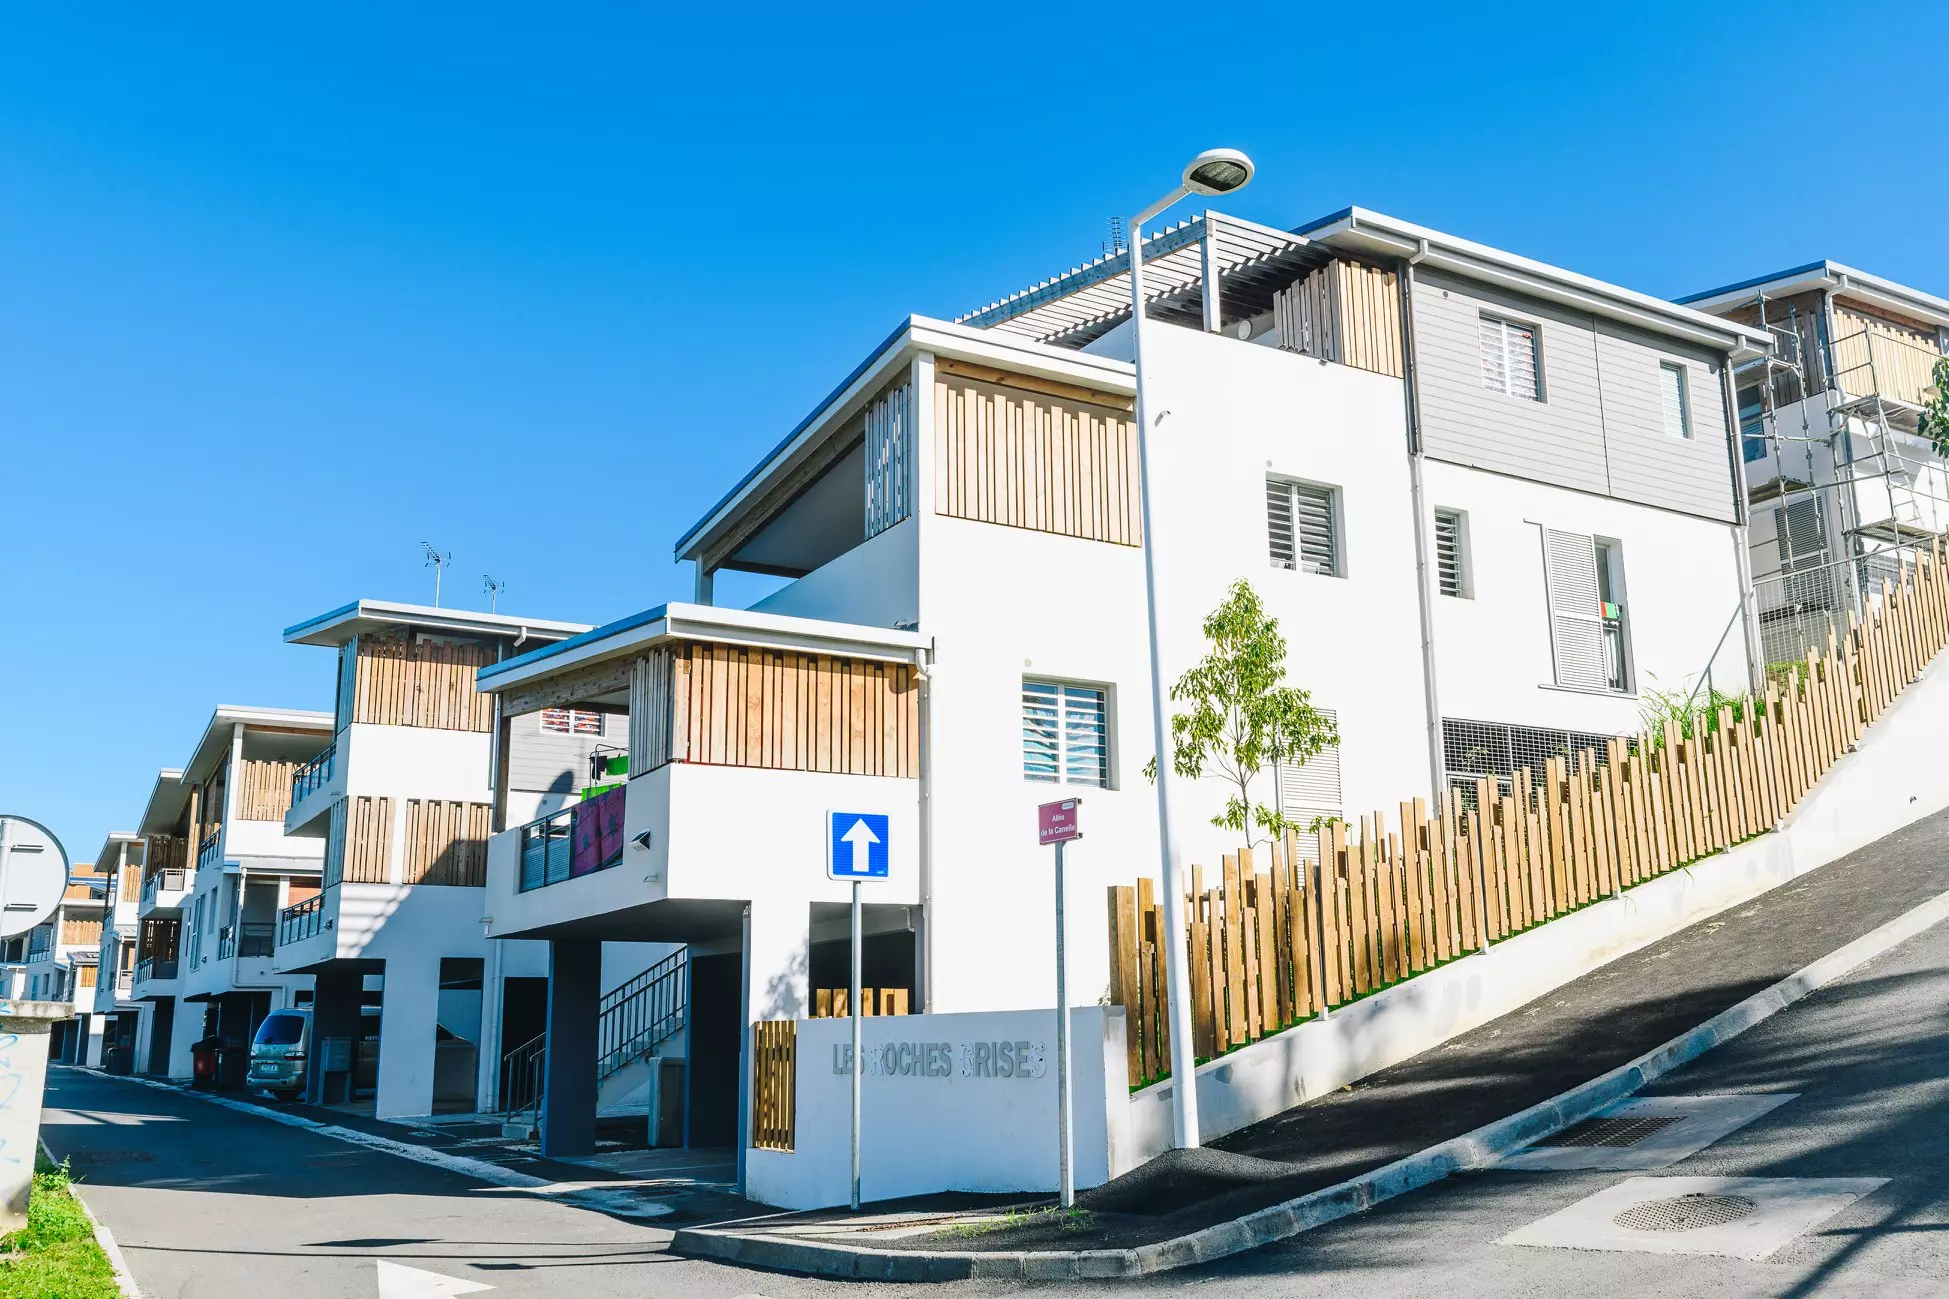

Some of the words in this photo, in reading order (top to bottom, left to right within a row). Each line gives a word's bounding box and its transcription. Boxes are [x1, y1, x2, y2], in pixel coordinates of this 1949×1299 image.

[1040, 829, 1048, 837] de
[1048, 827, 1054, 835] la
[870, 1042, 952, 1077] ROCHES
[959, 1040, 1047, 1079] GRISES
